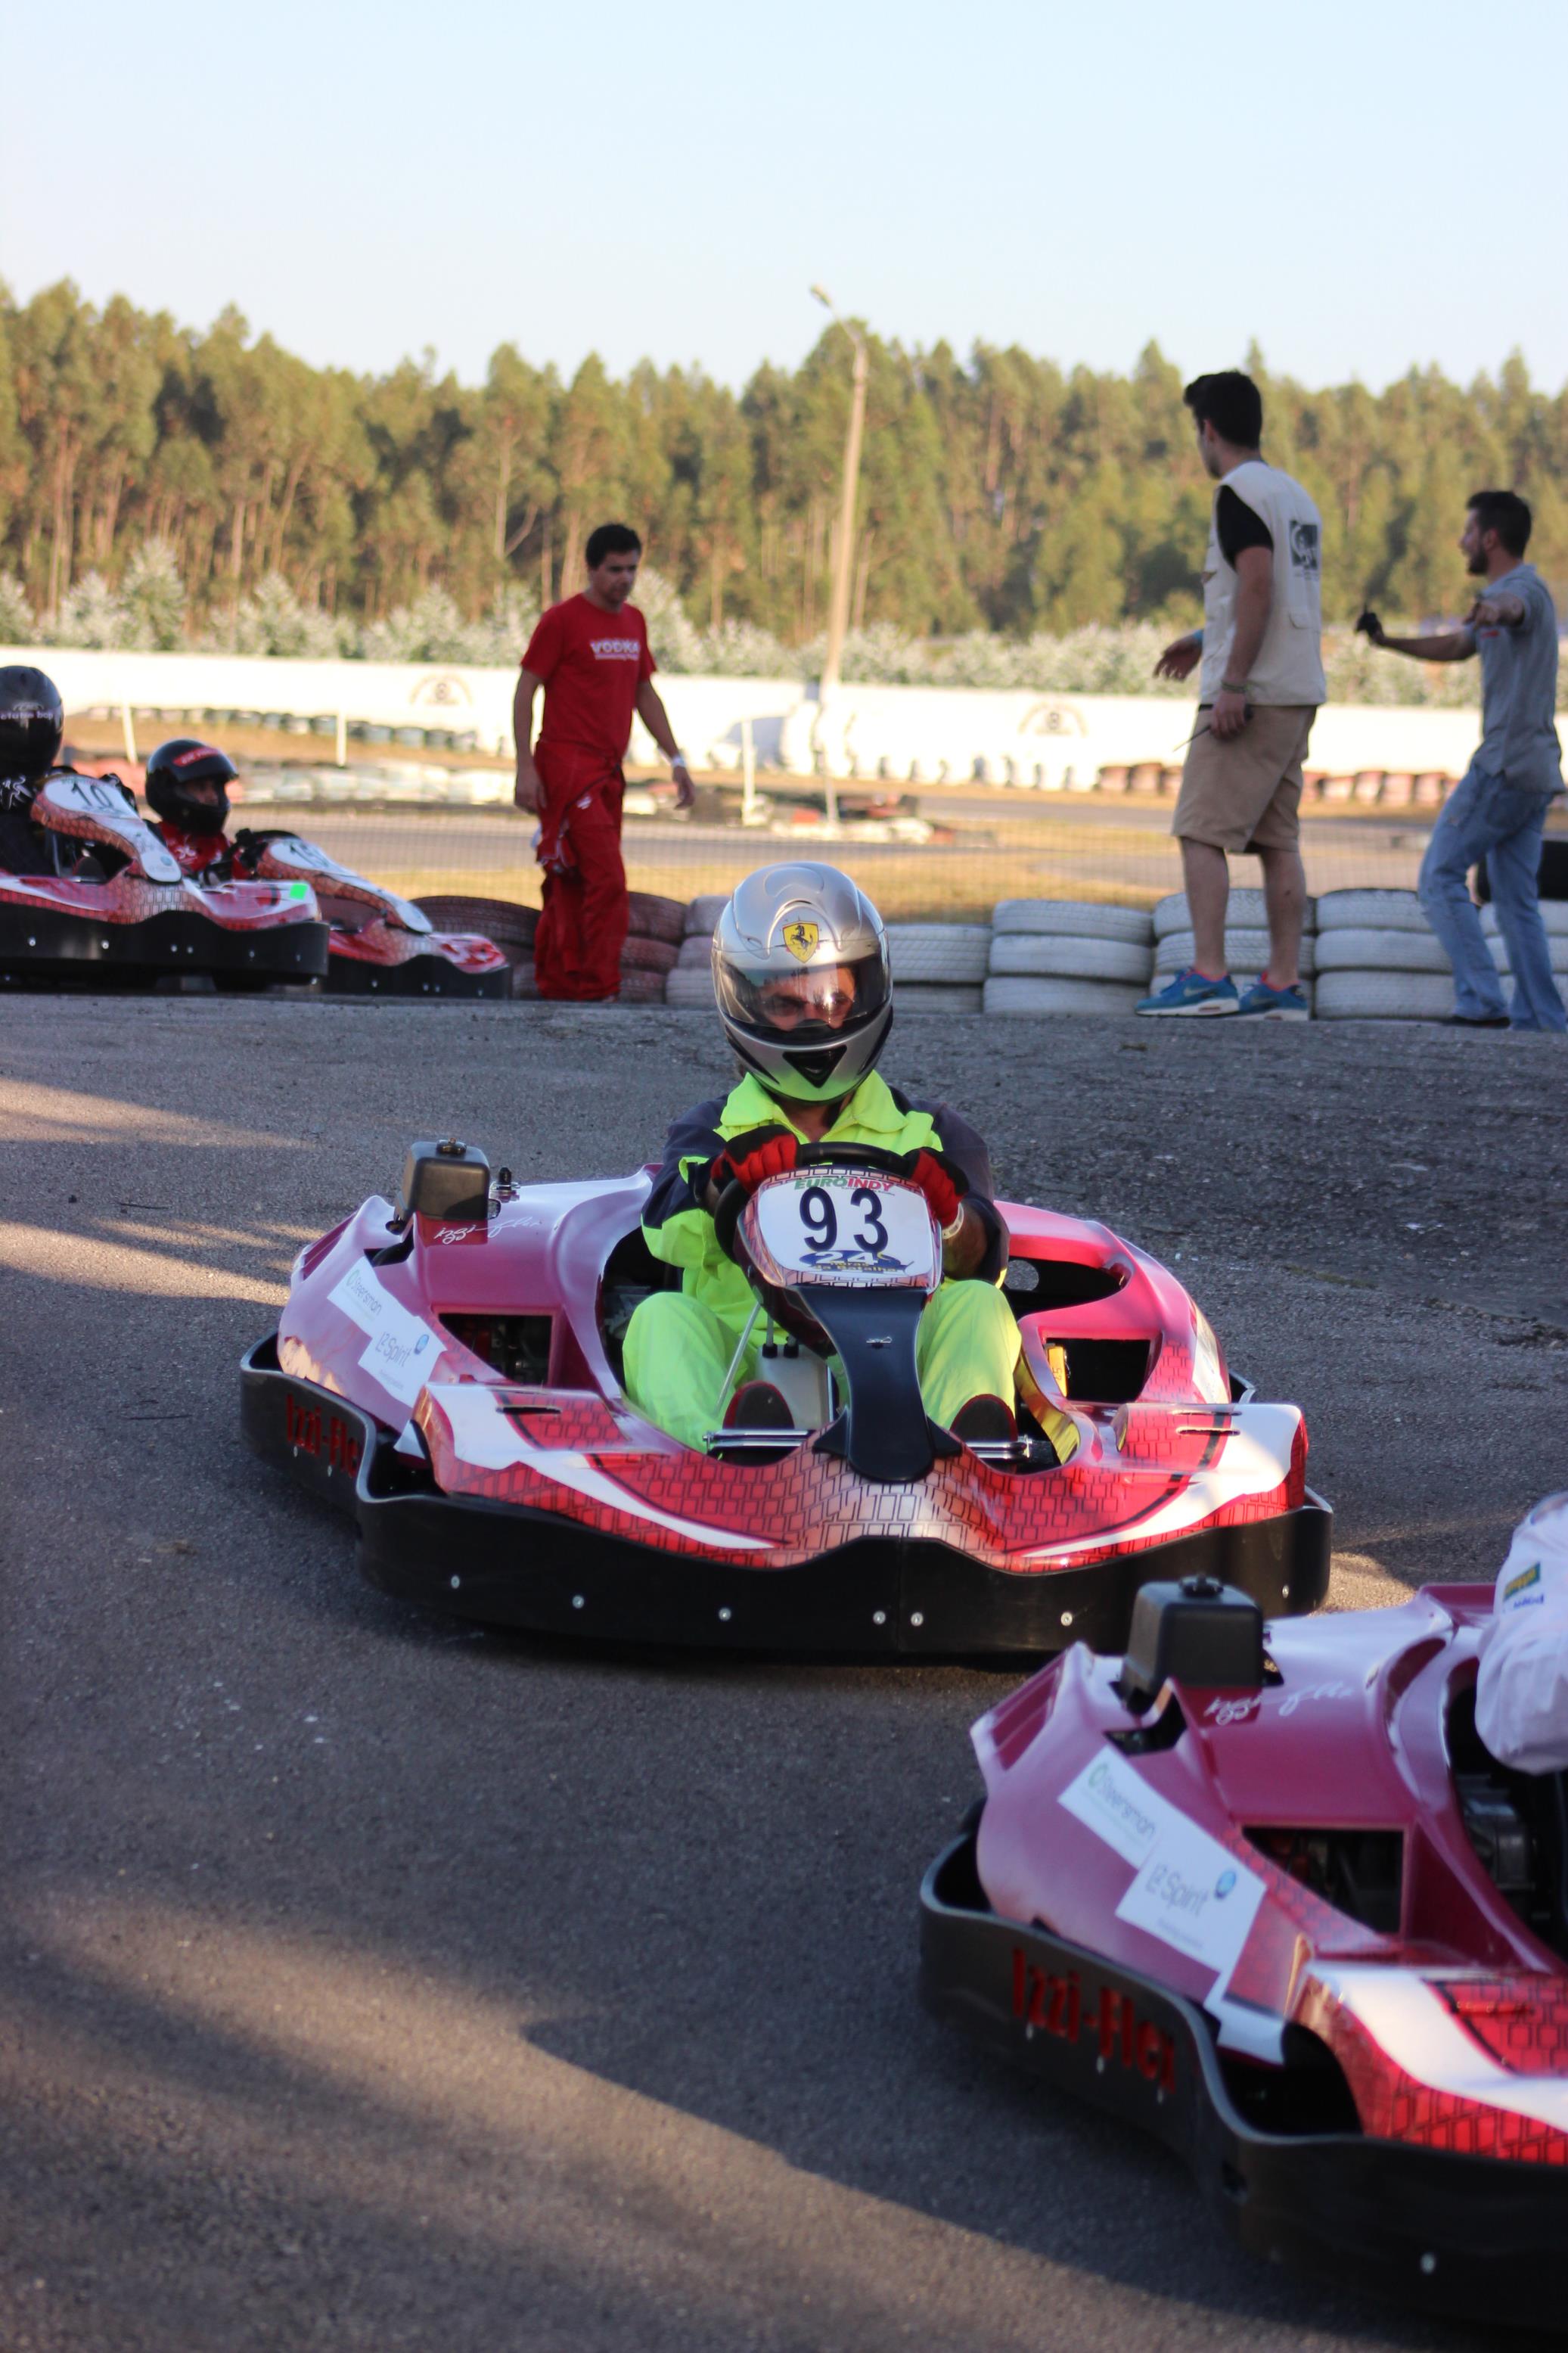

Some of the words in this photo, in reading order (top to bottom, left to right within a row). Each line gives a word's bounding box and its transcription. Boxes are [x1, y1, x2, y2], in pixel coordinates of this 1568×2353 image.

[71, 782, 113, 807] 10
[800, 1186, 888, 1253] 93
[815, 1251, 878, 1266] 24
